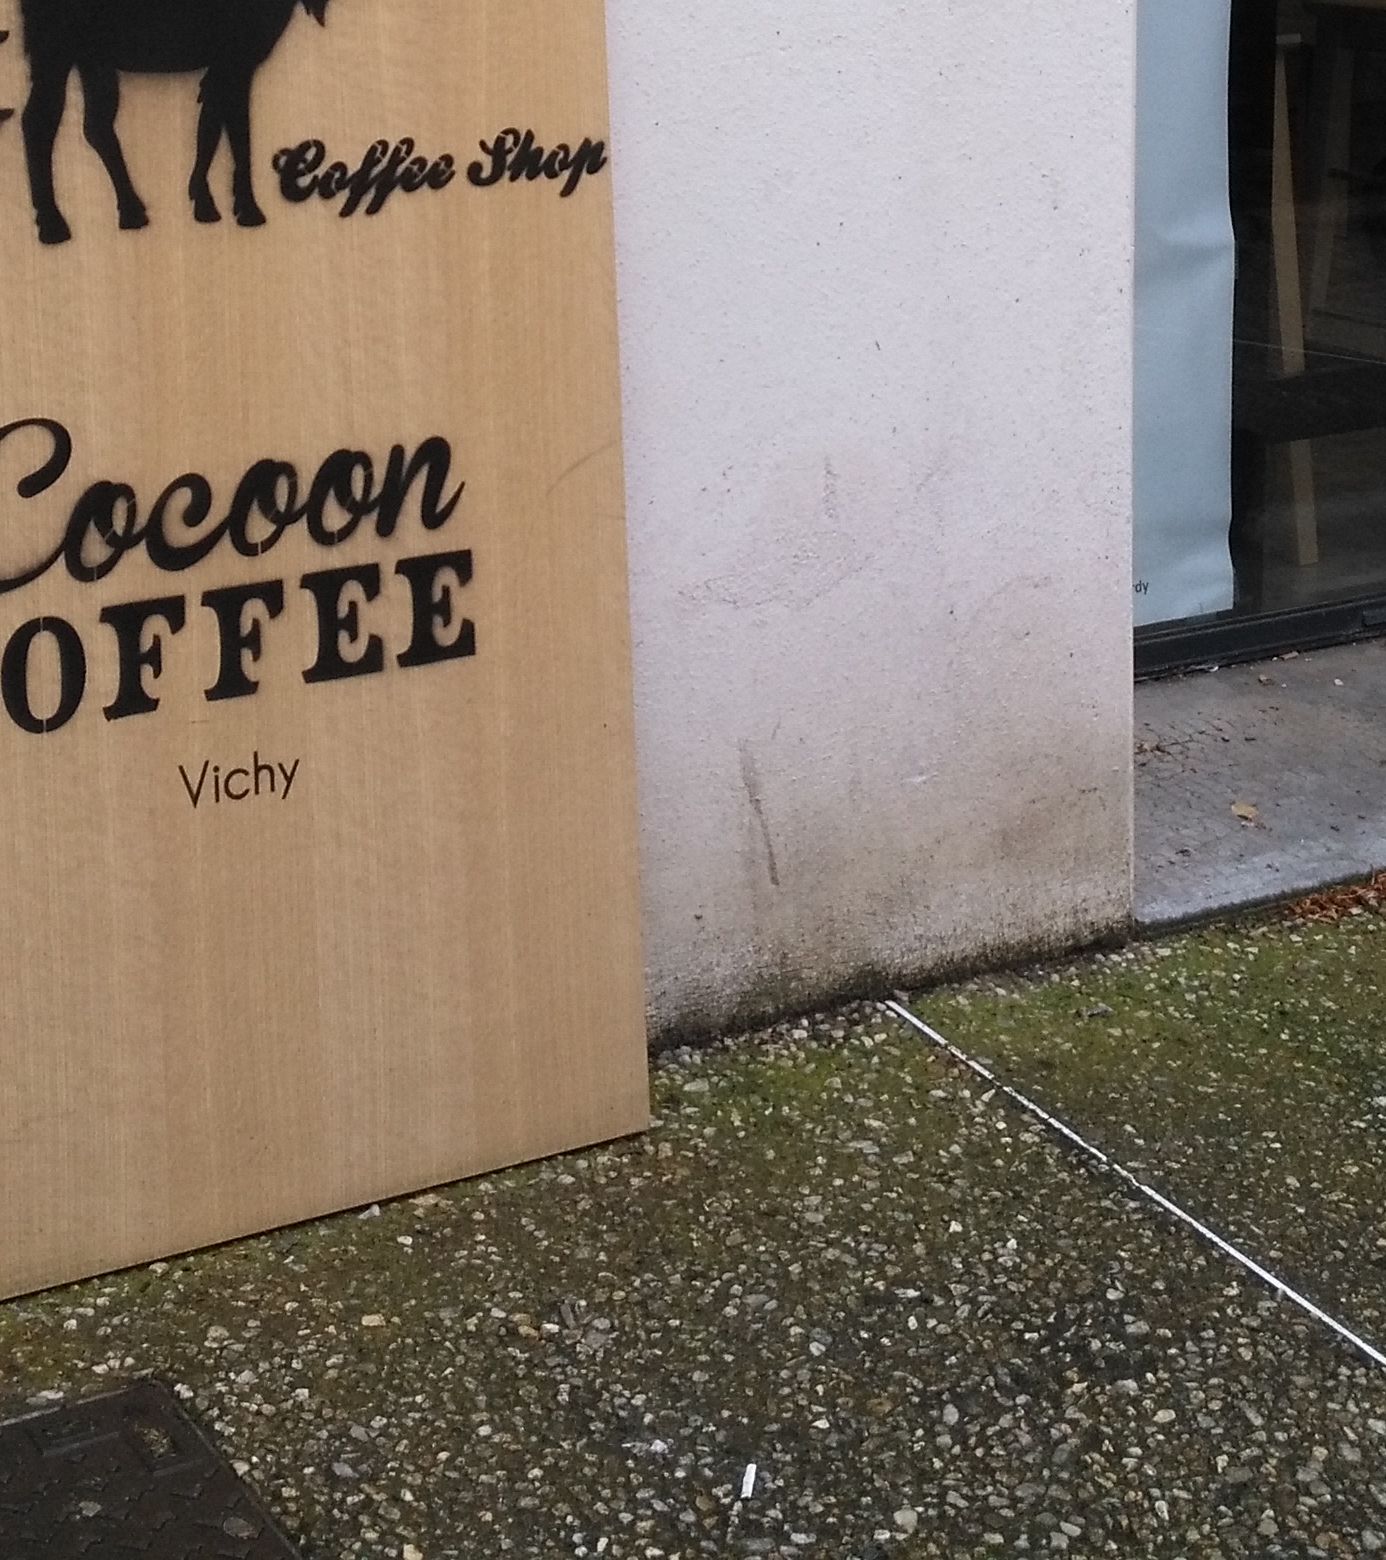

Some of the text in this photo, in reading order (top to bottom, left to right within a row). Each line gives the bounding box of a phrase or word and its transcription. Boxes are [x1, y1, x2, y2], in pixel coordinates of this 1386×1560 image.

[271, 126, 608, 218] Coffee Shop
[1132, 580, 1149, 596] dy
[178, 750, 300, 810] Vichy
